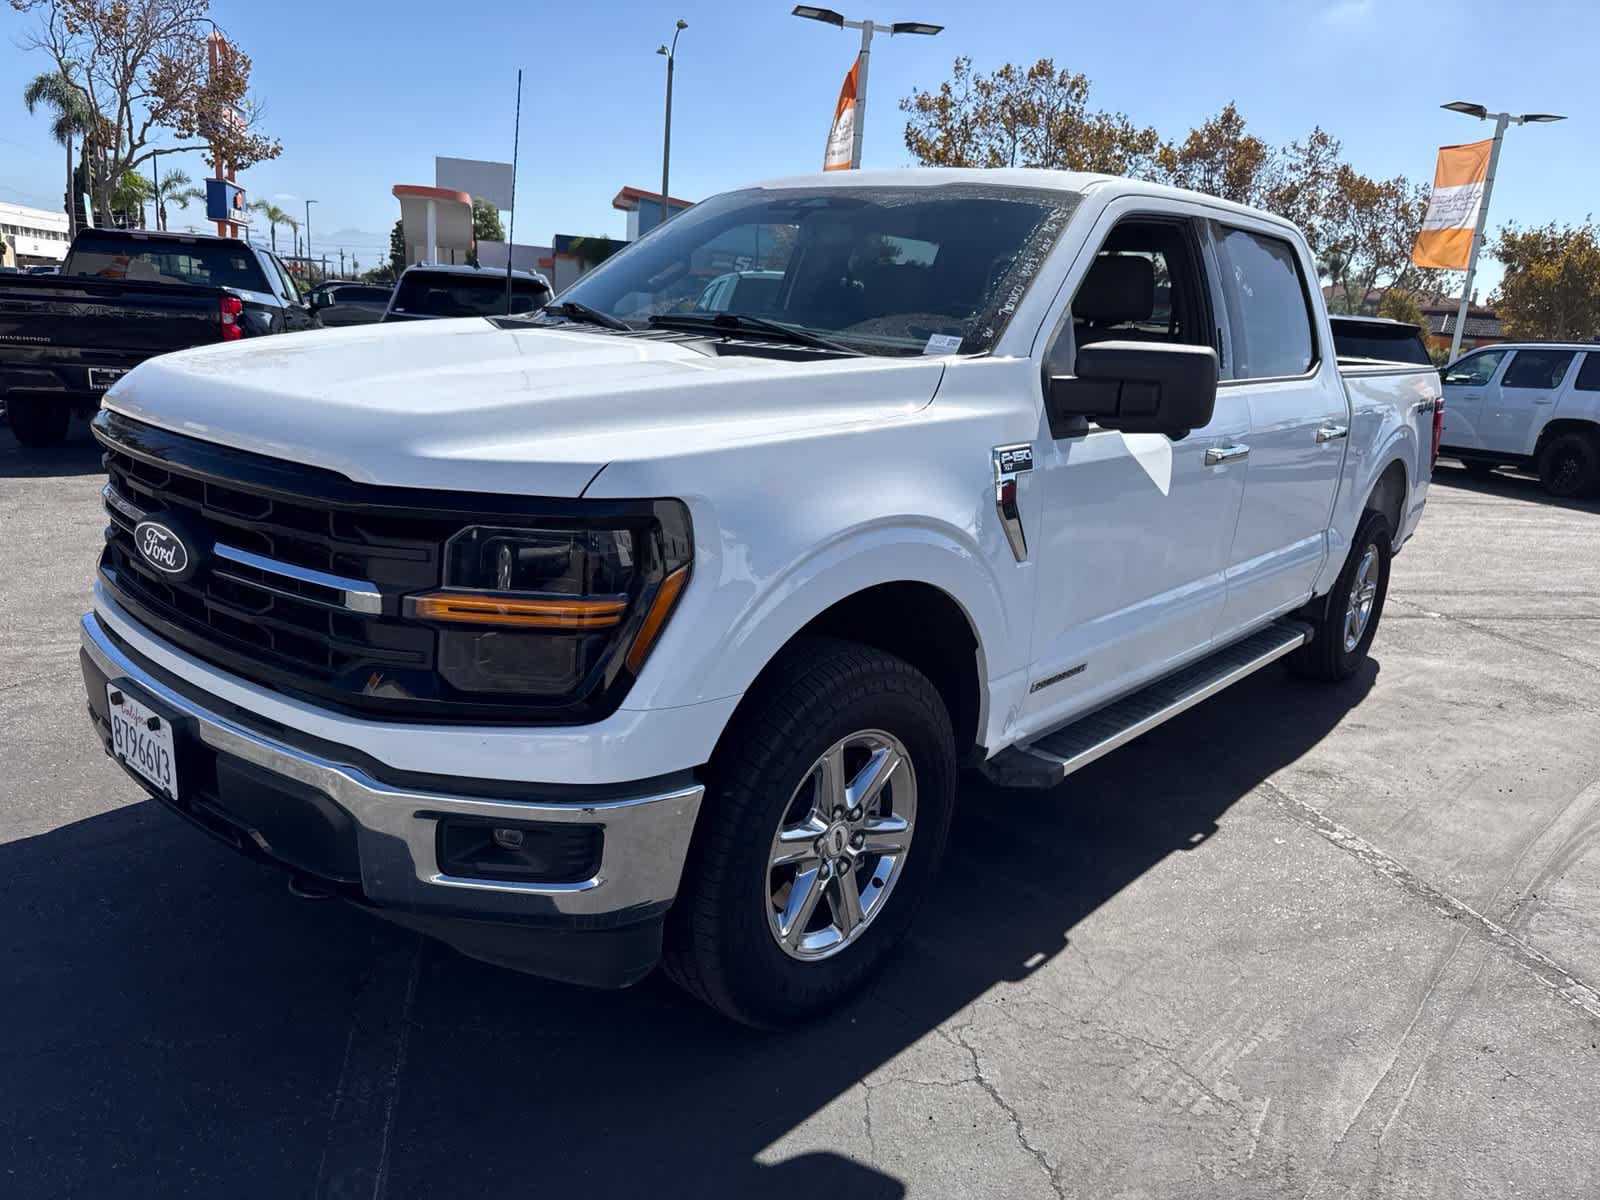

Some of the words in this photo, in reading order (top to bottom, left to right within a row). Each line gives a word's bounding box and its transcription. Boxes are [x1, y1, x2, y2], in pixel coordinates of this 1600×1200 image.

[0, 335, 52, 344] ILVERADO
[1001, 449, 1032, 464] F-150
[143, 527, 177, 567] Ford
[113, 714, 171, 785] 87966V3
